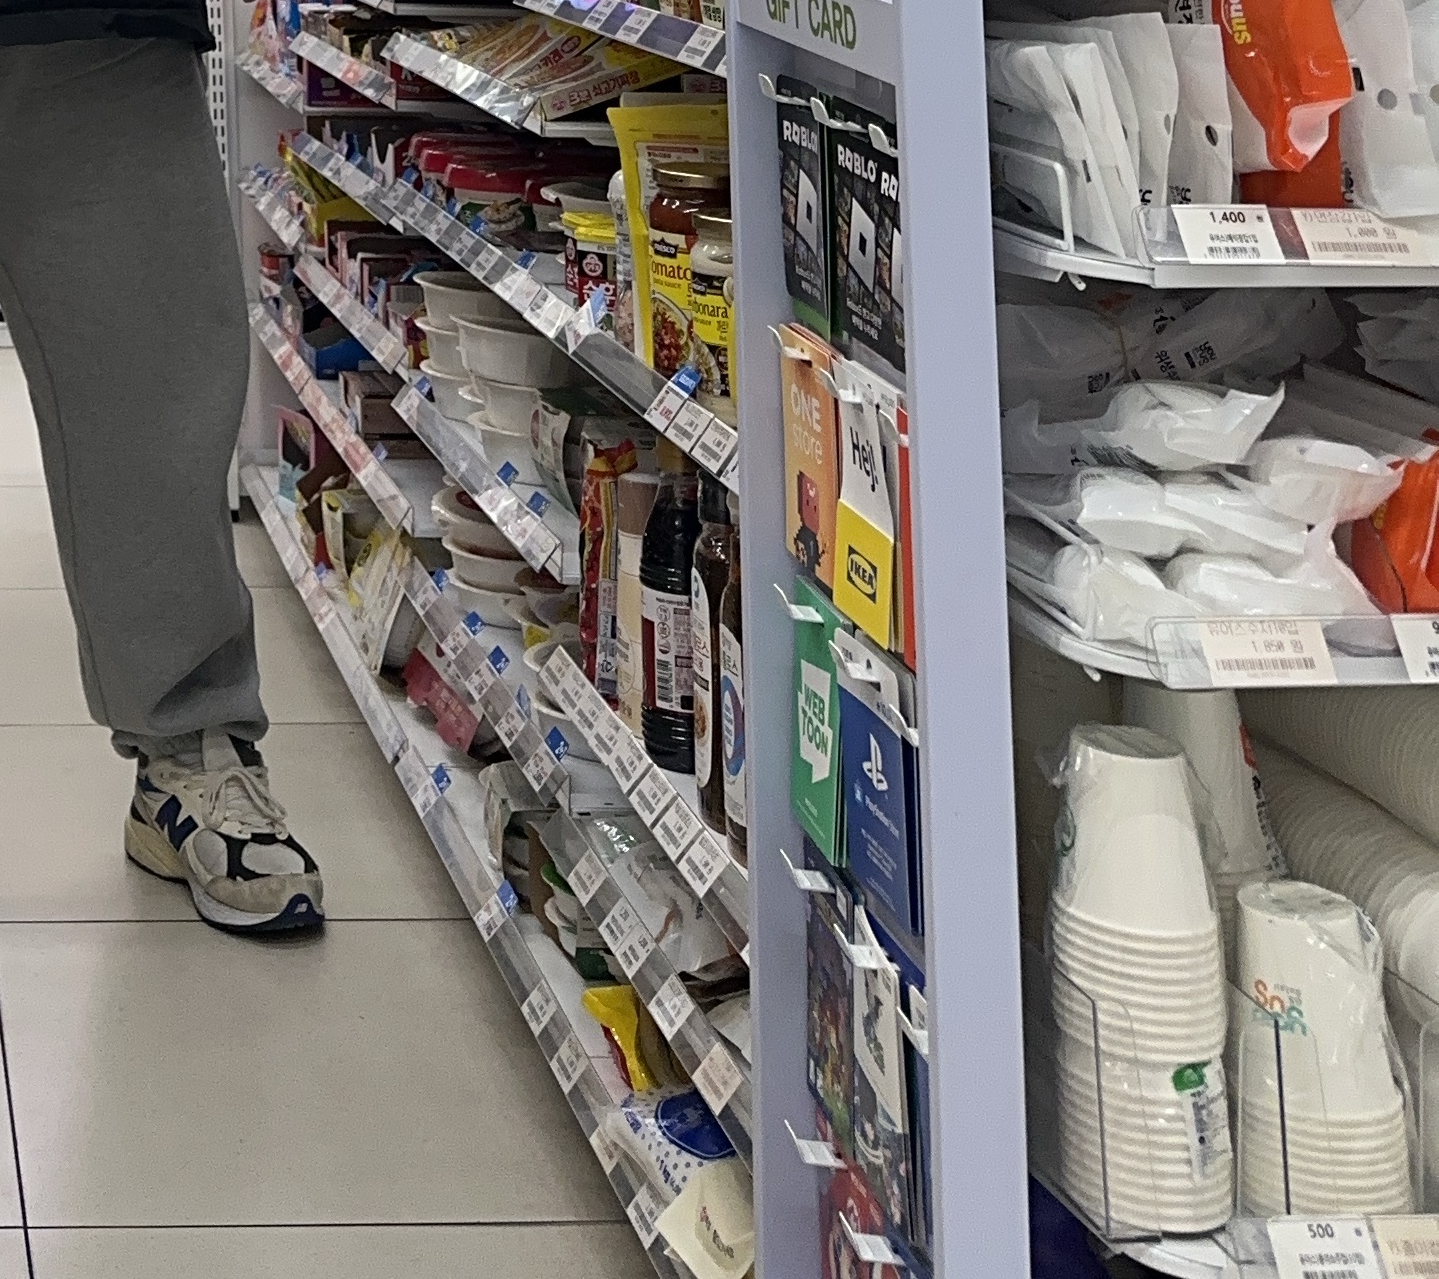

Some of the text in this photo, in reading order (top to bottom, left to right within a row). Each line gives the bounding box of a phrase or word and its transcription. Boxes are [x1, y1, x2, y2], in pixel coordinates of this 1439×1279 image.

[836, 143, 877, 184] ROBLO
[1209, 211, 1247, 225] 1,400
[790, 382, 823, 433] ONE
[792, 422, 824, 466] store
[849, 426, 880, 493] Hej!
[849, 558, 878, 591] IKEA
[804, 682, 826, 728] WEB
[801, 705, 829, 759] TOON
[1307, 1223, 1335, 1239] 500
